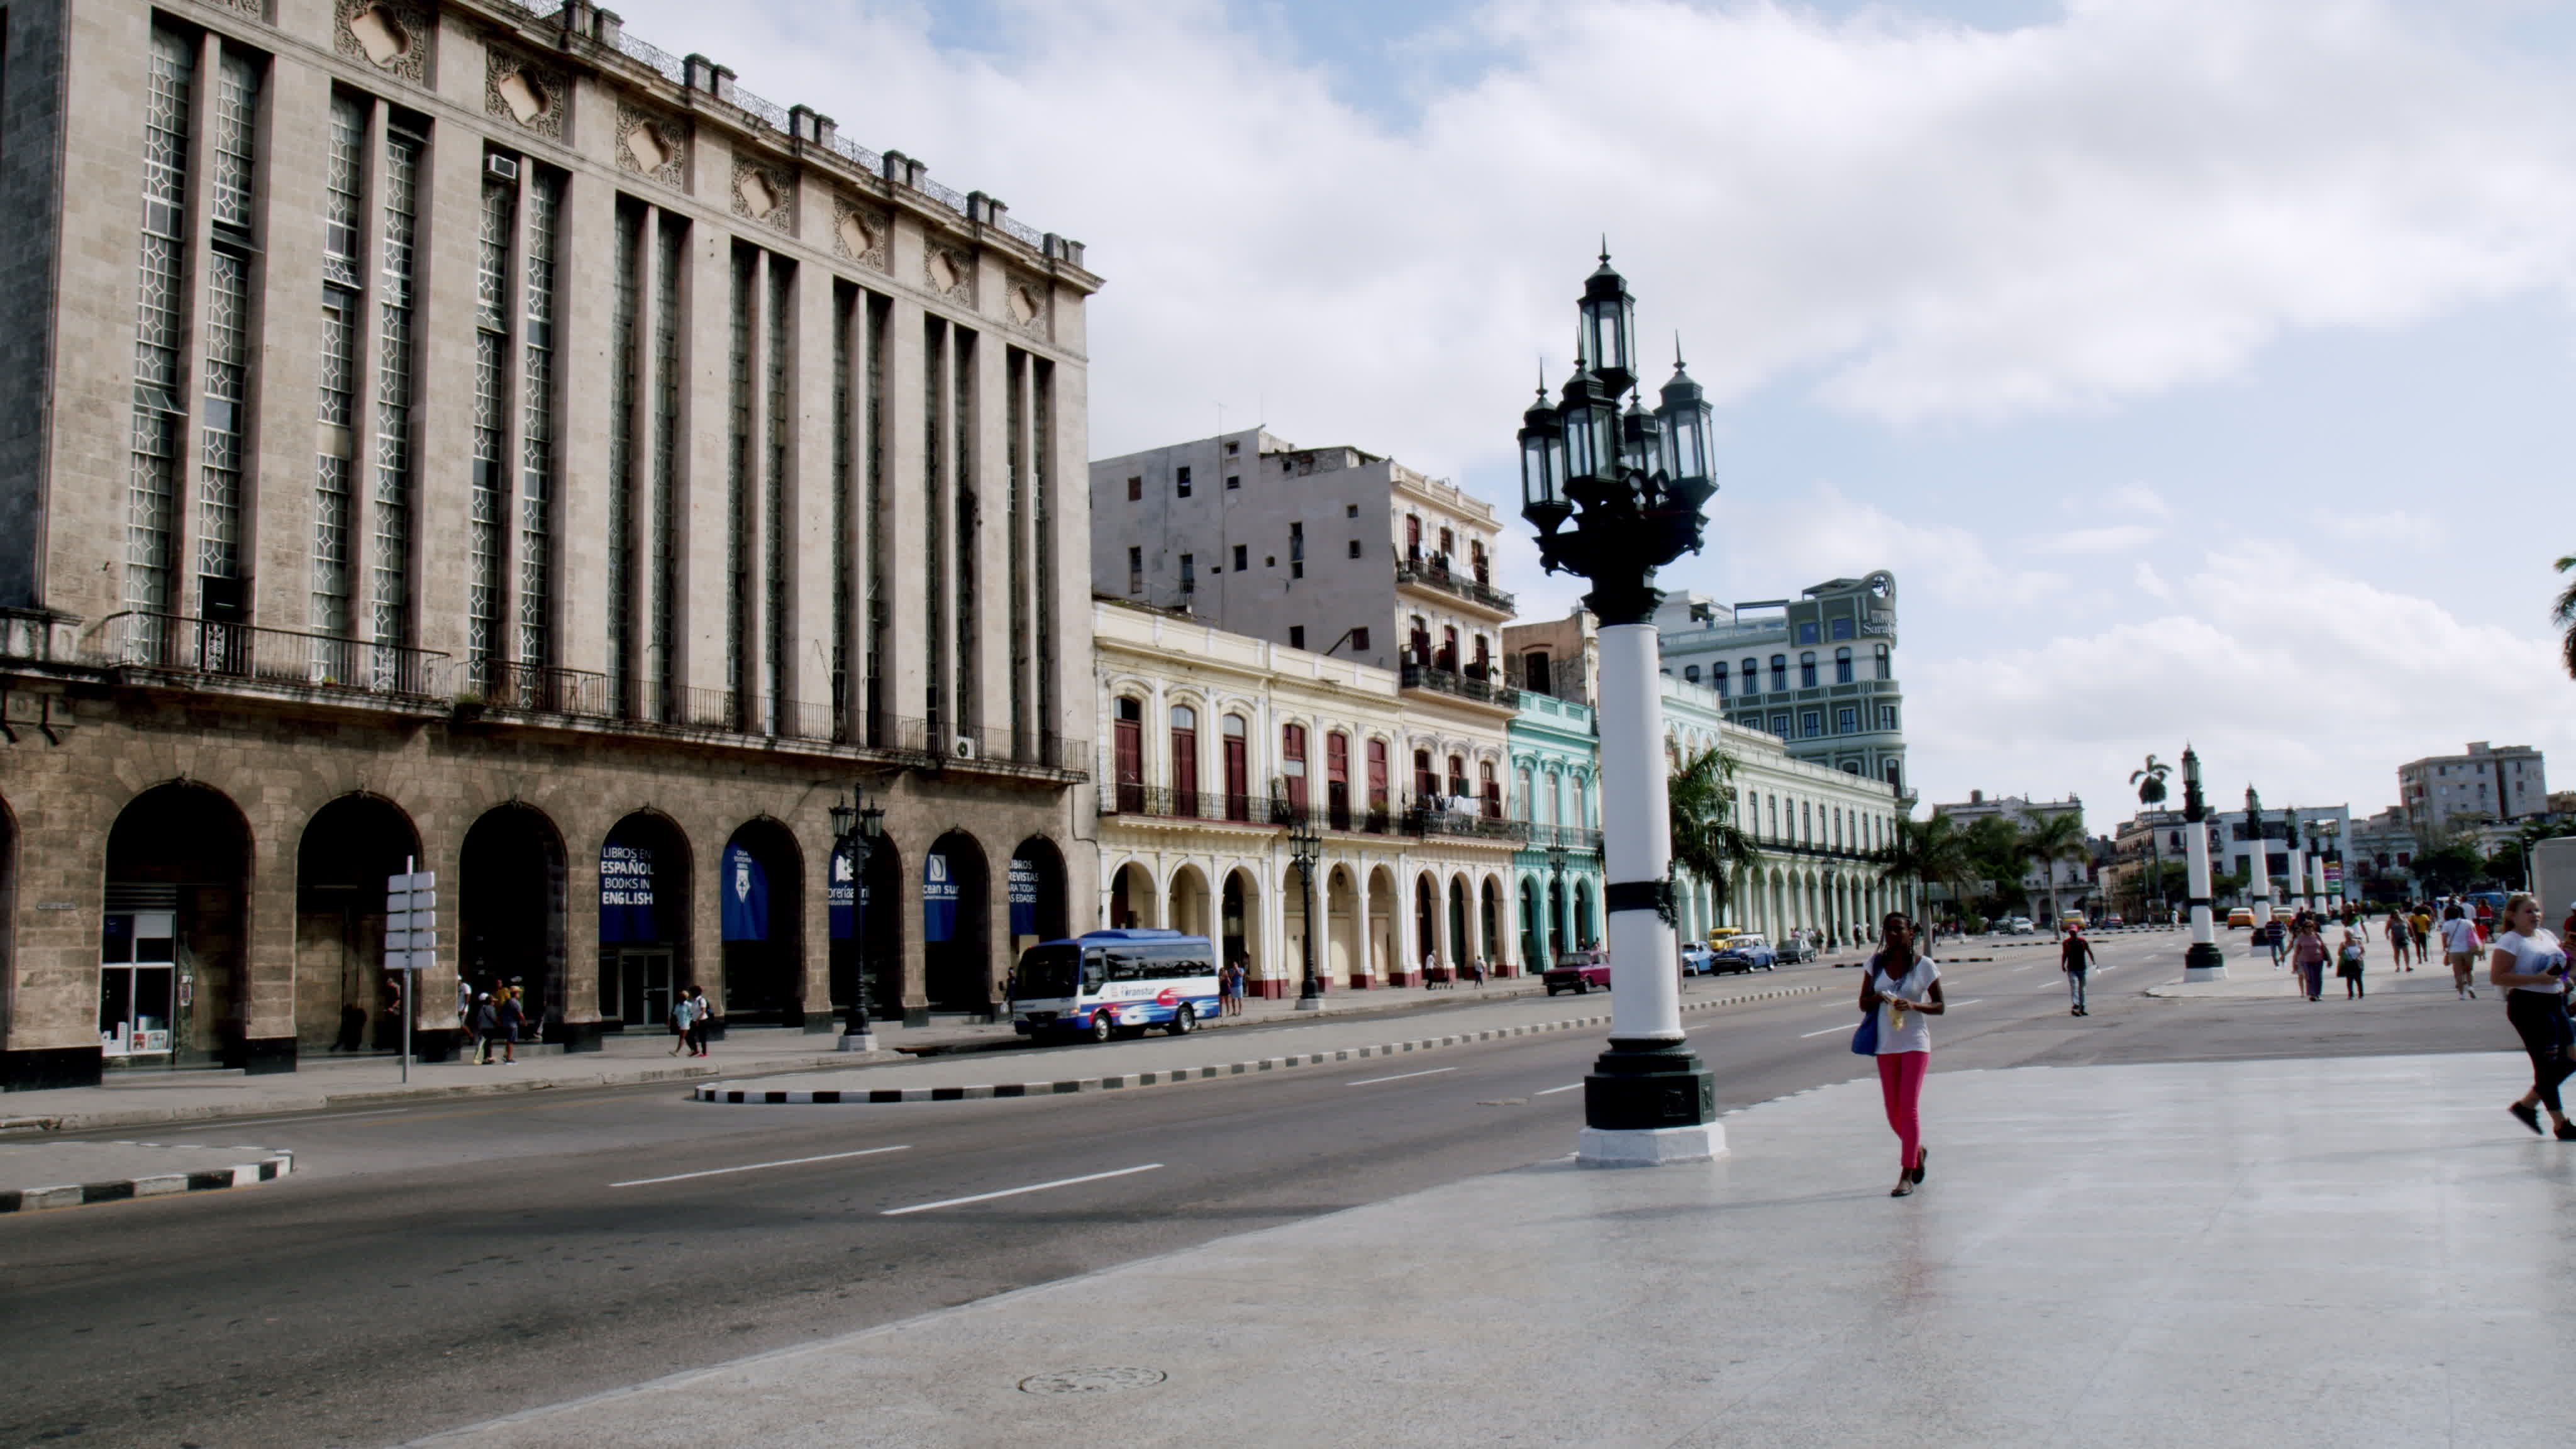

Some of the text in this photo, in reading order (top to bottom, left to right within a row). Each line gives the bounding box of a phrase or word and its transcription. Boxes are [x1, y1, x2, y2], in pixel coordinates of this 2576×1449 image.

[603, 847, 652, 860] LIBROS EN
[601, 859, 654, 875] ESPAÑOL
[604, 877, 650, 890] BOOKS IN
[923, 885, 941, 894] cean
[602, 891, 653, 904] ENGLISH
